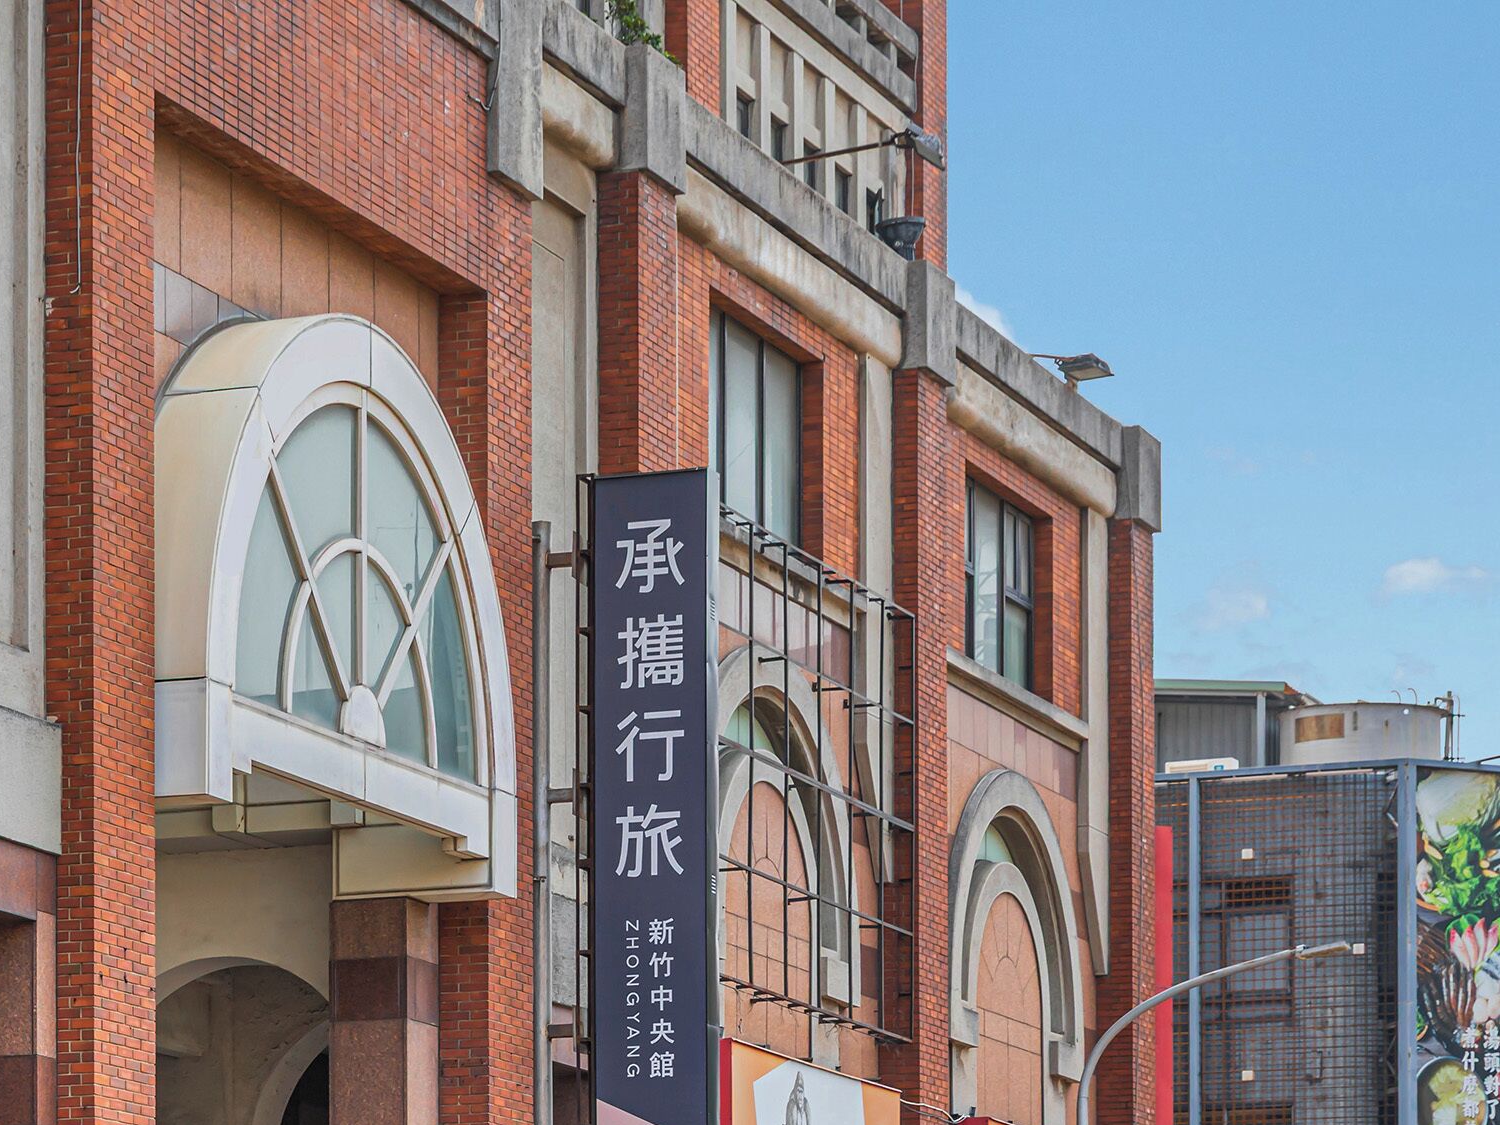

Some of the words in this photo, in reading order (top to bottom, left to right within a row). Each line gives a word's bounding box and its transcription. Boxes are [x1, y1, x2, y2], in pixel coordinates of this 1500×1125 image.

[615, 518, 685, 878] 承攜行旅
[625, 919, 641, 1078] ZHONGYANG
[648, 917, 675, 1079] 新竹中央館
